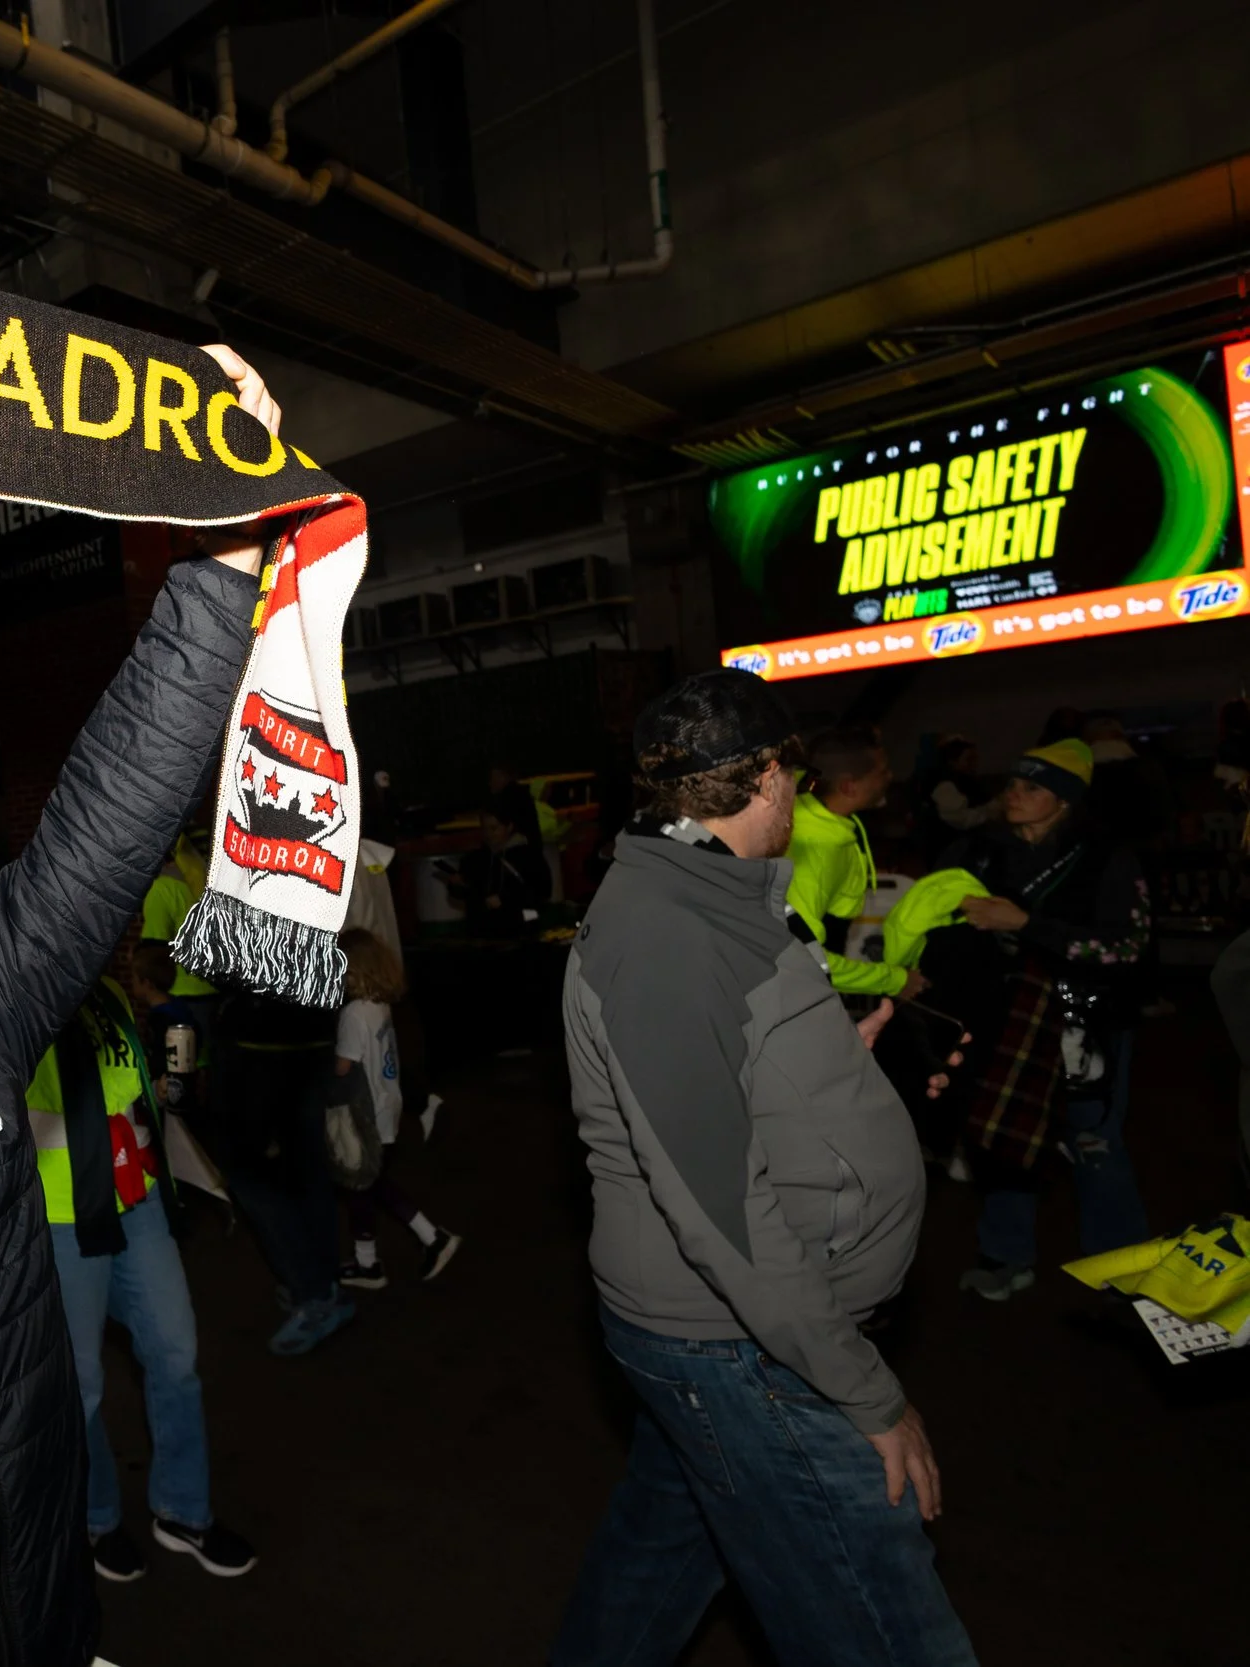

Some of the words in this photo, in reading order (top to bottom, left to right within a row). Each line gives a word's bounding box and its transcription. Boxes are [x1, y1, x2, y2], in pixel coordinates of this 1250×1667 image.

[865, 440, 922, 465] FOR
[947, 418, 1008, 443] THE
[1037, 382, 1152, 421] FIGHT
[814, 463, 942, 543] PUBLIC
[943, 427, 1088, 515] SAFETY
[51, 554, 107, 582] CAPITAL
[838, 497, 1066, 595] ADVISEMENT
[778, 651, 810, 667] It's
[814, 643, 852, 665] got
[855, 640, 881, 656] to
[884, 635, 914, 651] be
[930, 620, 978, 651] Tide
[993, 615, 1034, 635] It's
[1039, 608, 1086, 631] got
[1090, 604, 1122, 620] to
[1127, 597, 1164, 616] be
[1179, 578, 1240, 615] Tide
[258, 708, 326, 767] SPIRIT
